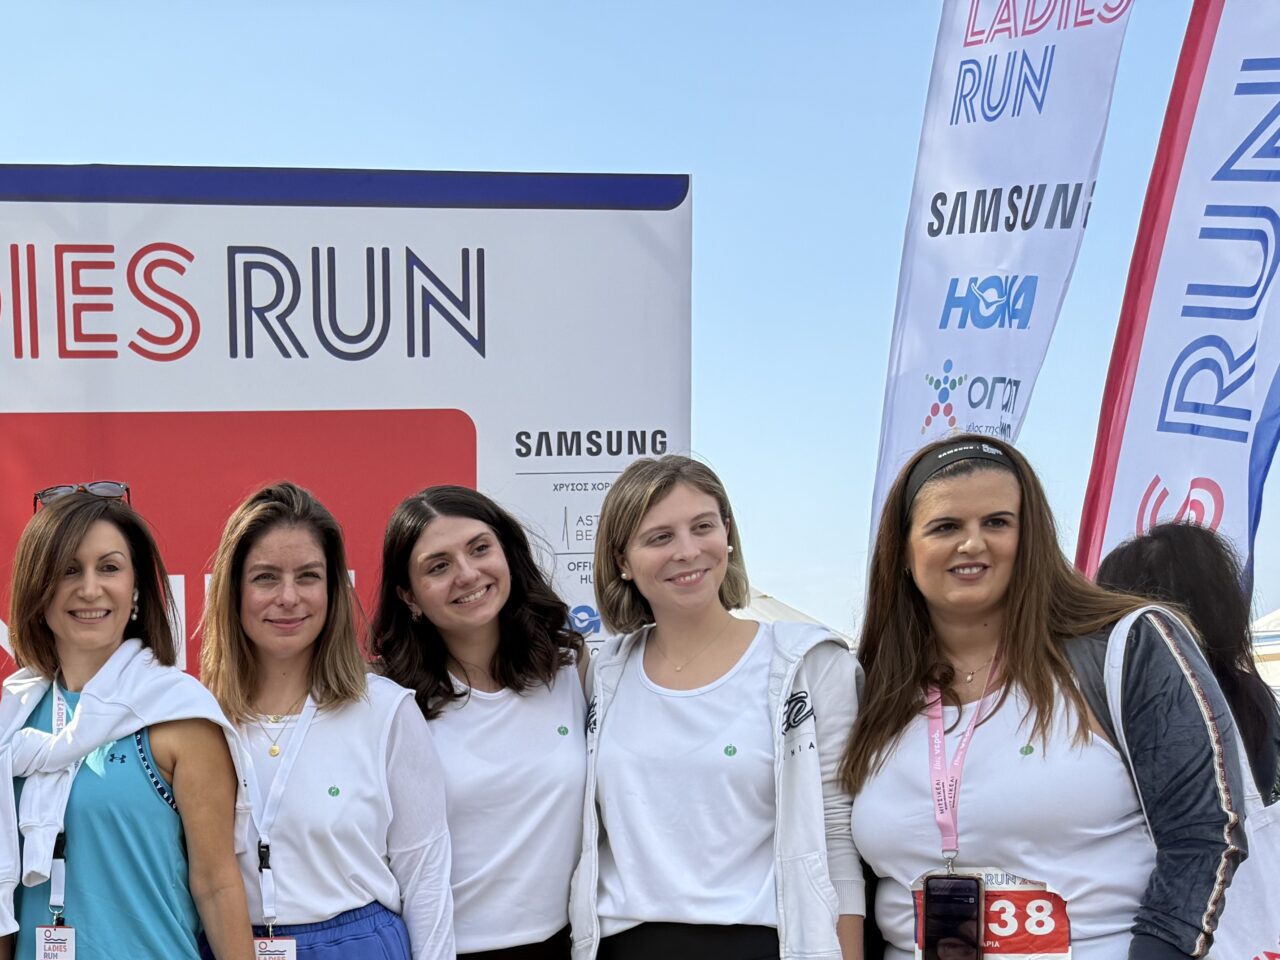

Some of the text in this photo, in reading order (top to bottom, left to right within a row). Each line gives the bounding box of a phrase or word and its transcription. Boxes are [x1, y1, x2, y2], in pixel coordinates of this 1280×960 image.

[950, 45, 1056, 126] RUN
[927, 180, 1097, 238] SAMSUN
[227, 245, 486, 362] RUN
[938, 274, 1039, 330] HOKA
[515, 429, 667, 458] SAMSUNG
[552, 483, 589, 492] ΧΡΥΣΟΣ
[567, 561, 592, 572] OFFI
[43, 944, 68, 953] LADIES
[43, 952, 59, 960] RUN
